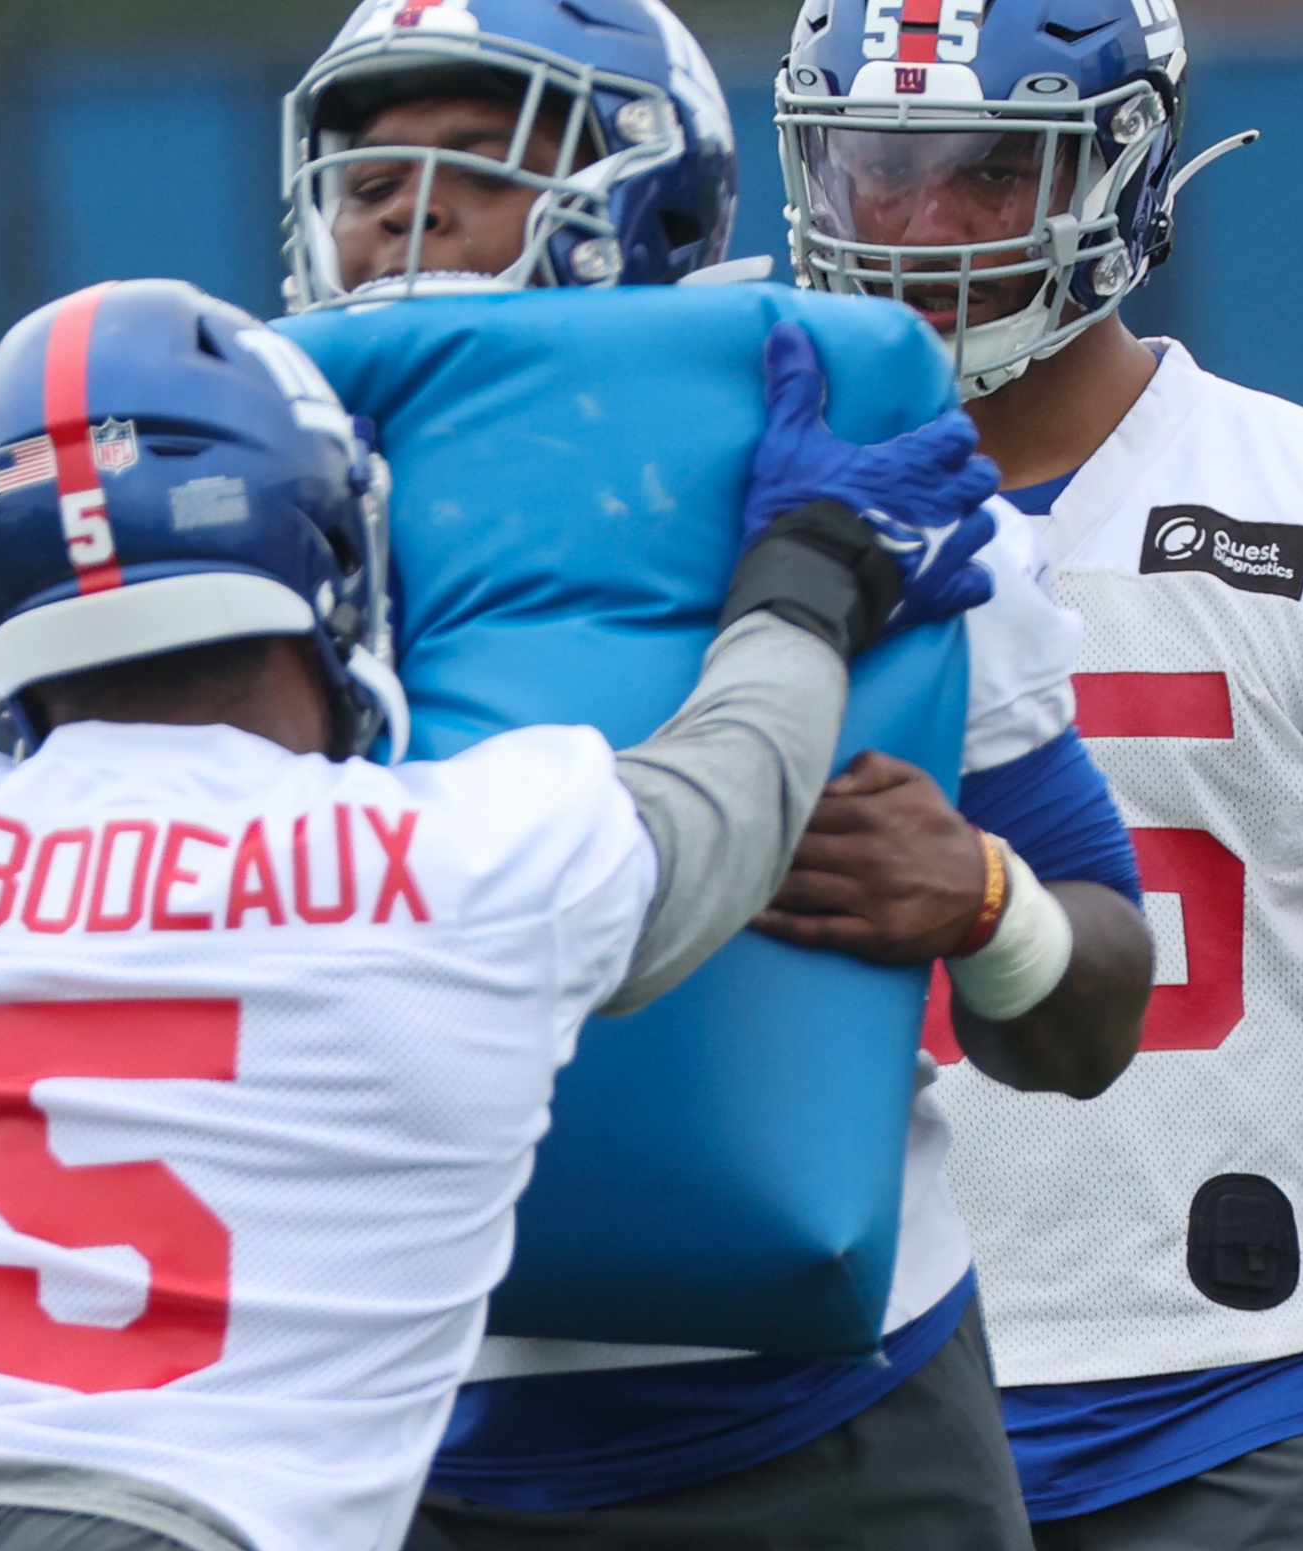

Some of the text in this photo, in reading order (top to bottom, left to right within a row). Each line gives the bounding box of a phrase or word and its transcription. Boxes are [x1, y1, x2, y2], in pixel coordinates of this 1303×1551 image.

[98, 440, 131, 464] NFL
[60, 488, 115, 565] 5
[1213, 530, 1280, 562] Quest
[1213, 546, 1294, 580] Diagnostics
